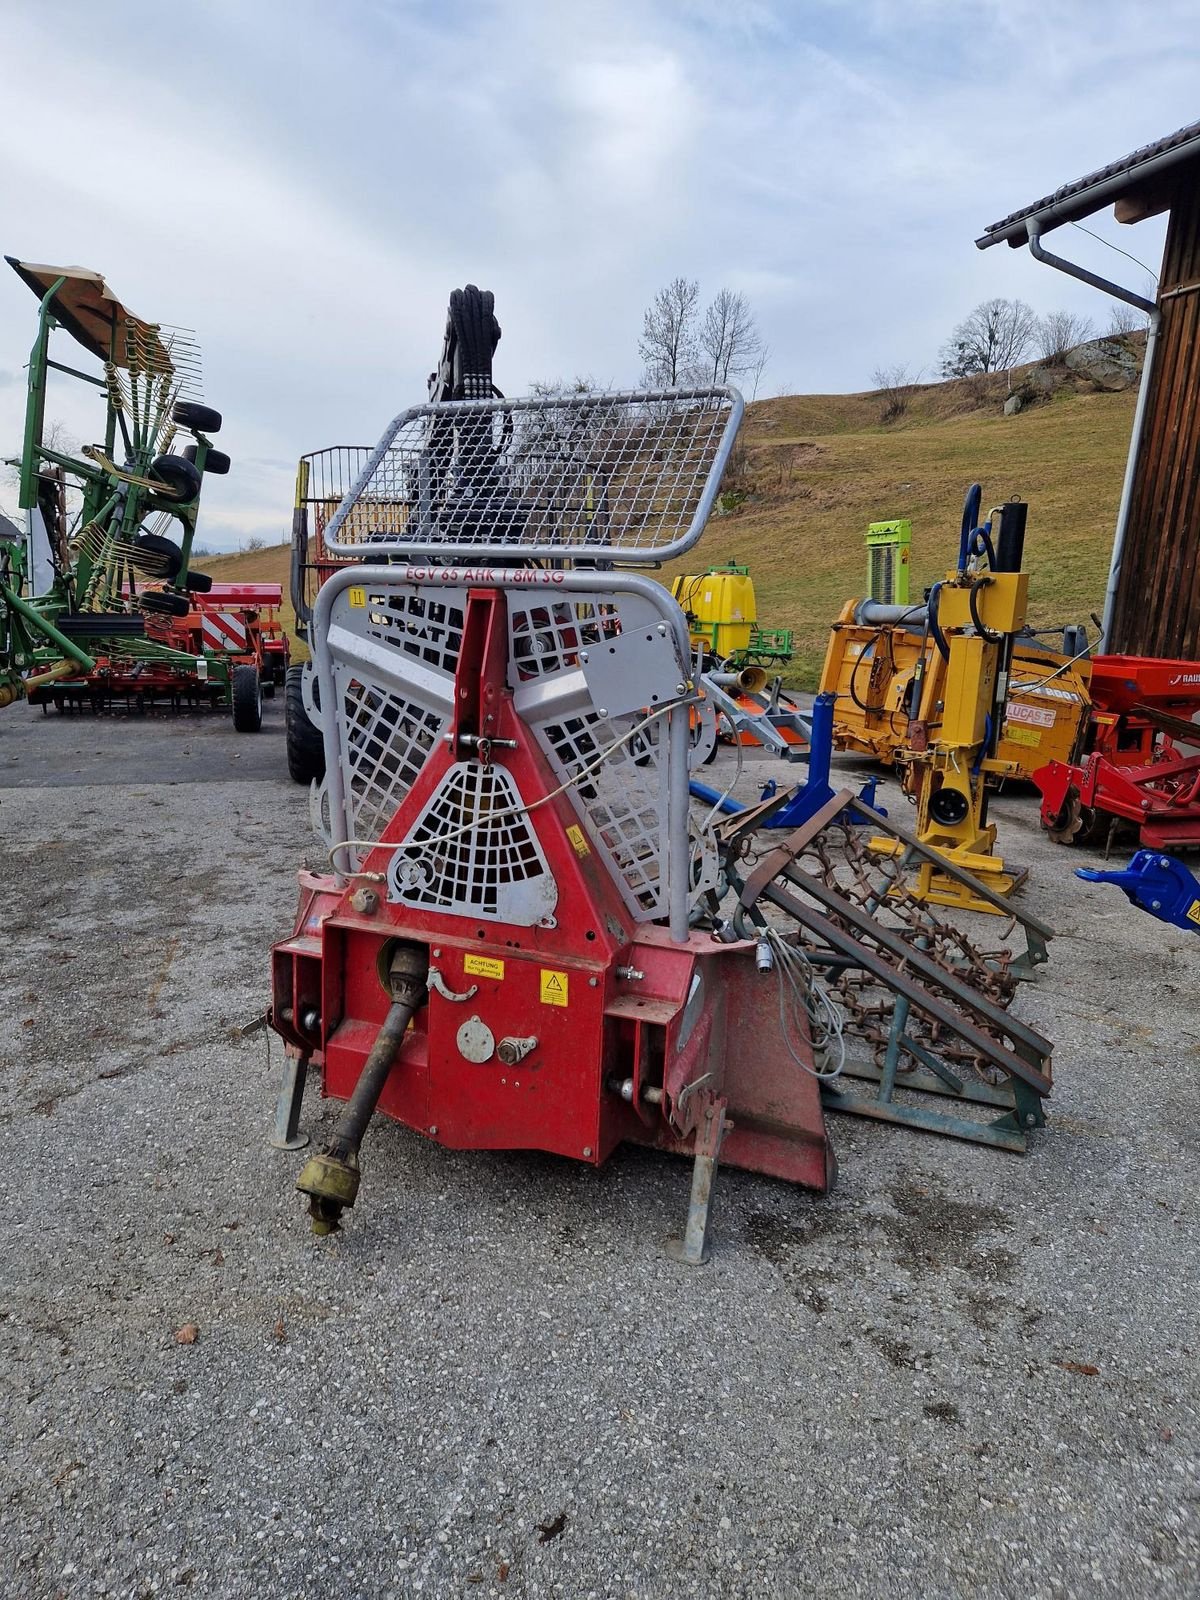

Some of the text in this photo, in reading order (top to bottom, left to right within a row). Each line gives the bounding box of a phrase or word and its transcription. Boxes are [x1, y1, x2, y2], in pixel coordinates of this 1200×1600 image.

[406, 567, 564, 584] EGV 65 AHK 1.8M SG
[1007, 705, 1041, 721] LUCAS
[470, 960, 498, 969] ACHTUNG
